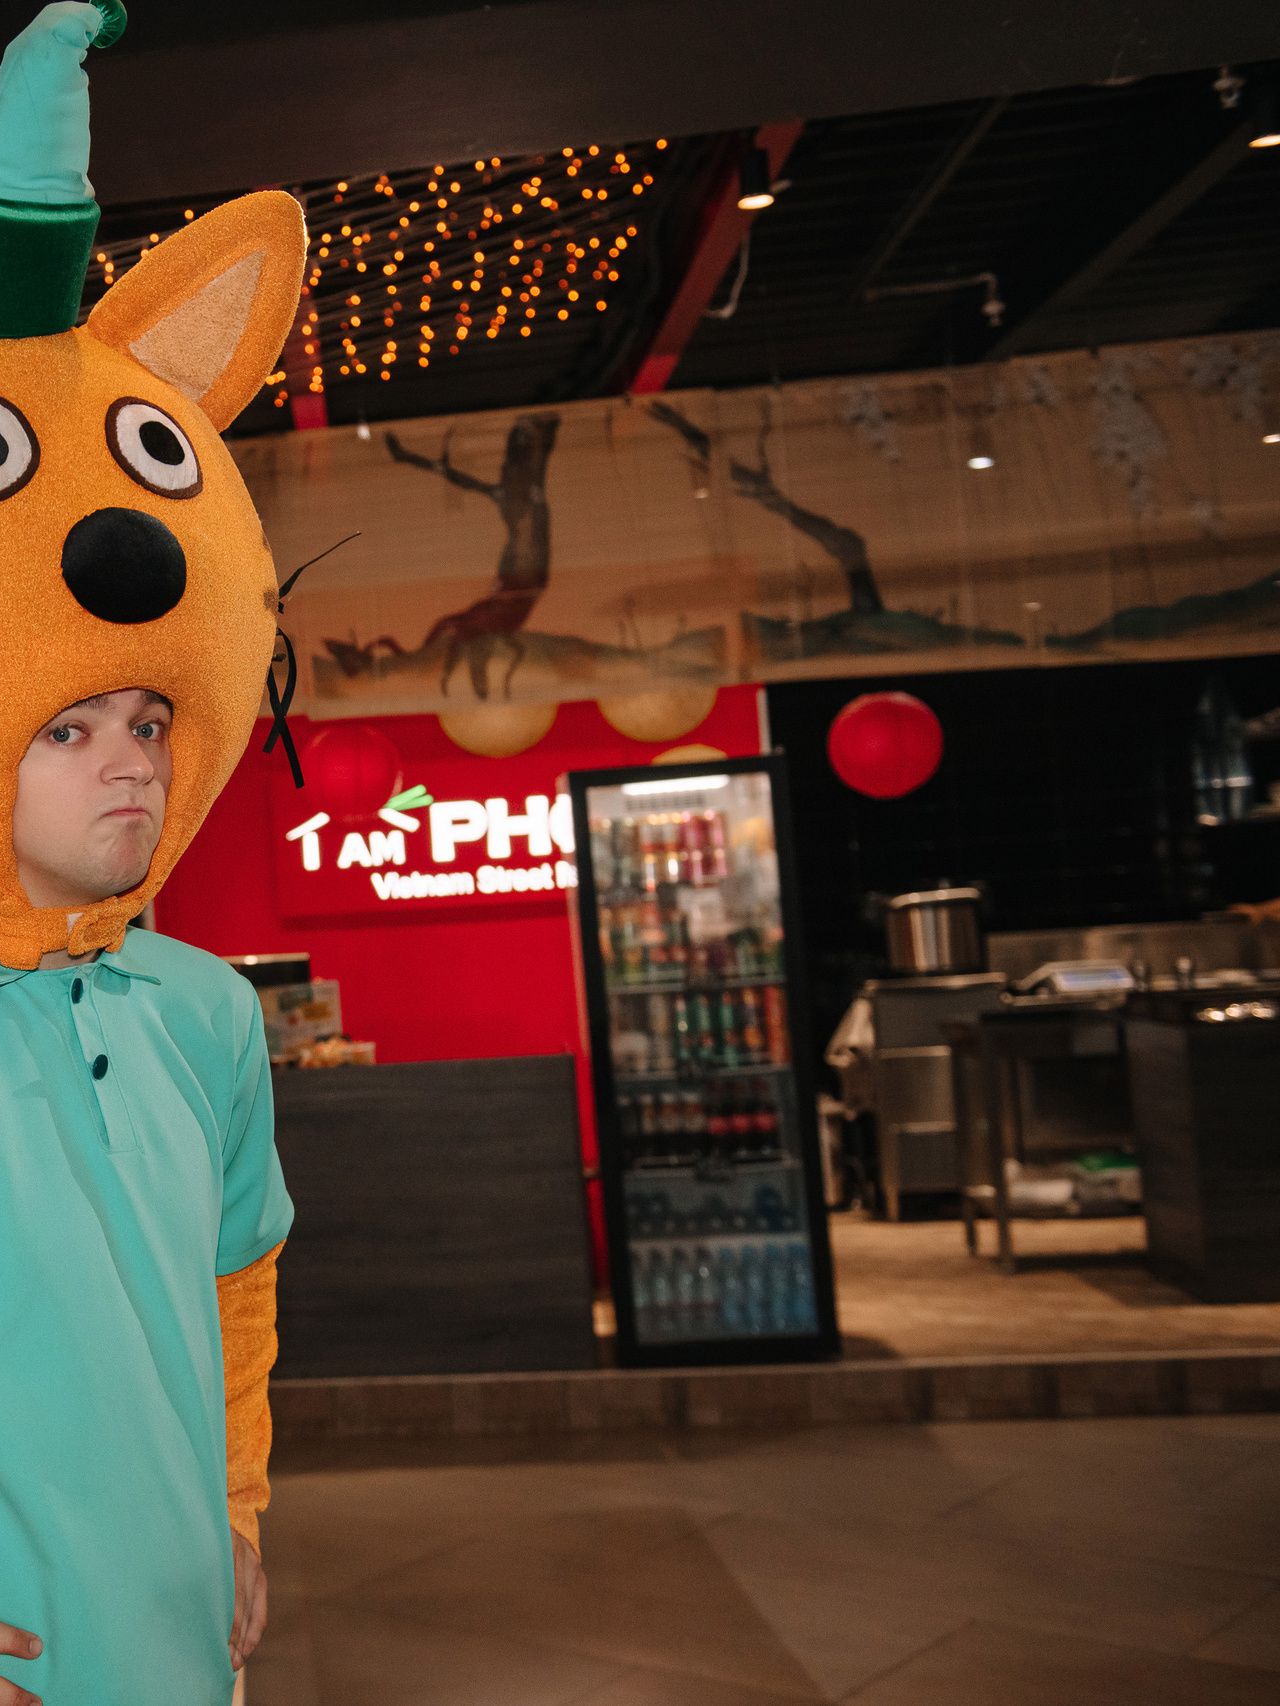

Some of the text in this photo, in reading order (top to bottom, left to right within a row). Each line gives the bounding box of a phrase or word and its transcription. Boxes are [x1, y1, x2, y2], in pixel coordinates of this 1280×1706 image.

[337, 829, 406, 869] AM
[370, 871, 475, 900] Vietnam
[476, 862, 555, 894] Street
